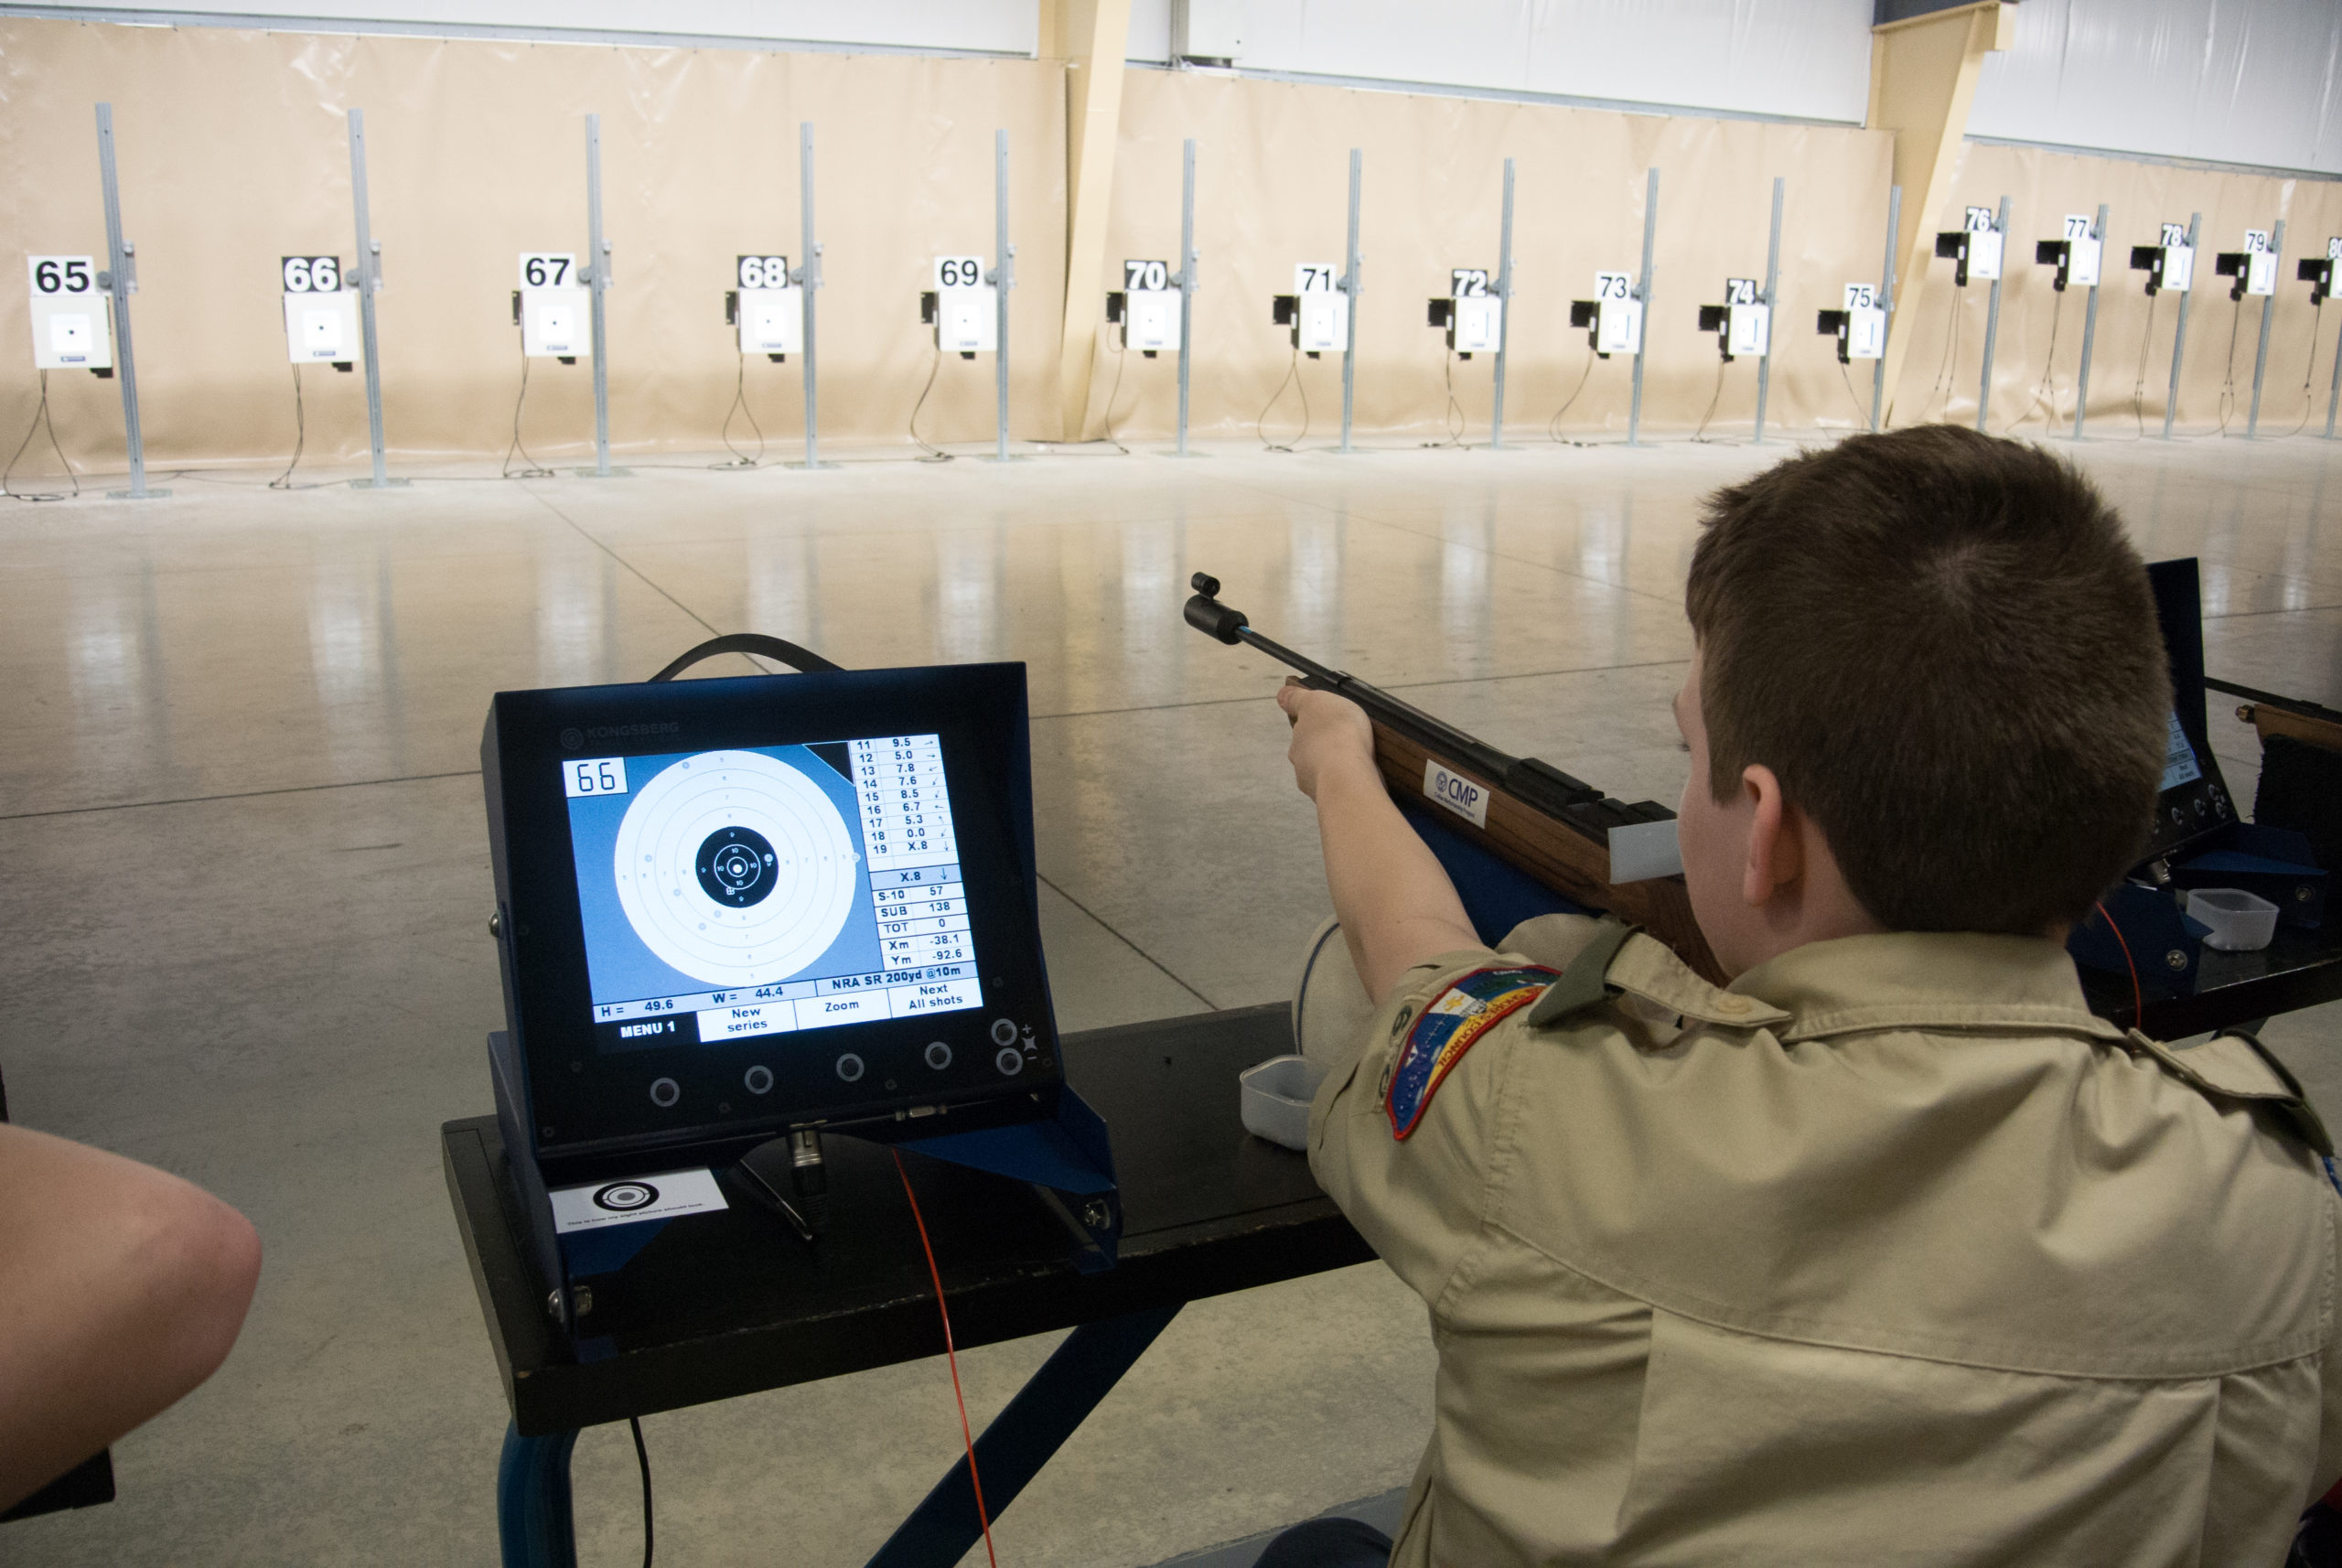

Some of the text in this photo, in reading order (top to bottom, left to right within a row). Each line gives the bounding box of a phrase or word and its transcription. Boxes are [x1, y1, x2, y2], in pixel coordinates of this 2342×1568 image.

[1967, 208, 1991, 231] 76
[2068, 219, 2086, 237] 77
[2161, 224, 2182, 246] 78
[2248, 233, 2264, 252] 79
[36, 261, 90, 293] 65
[284, 257, 338, 293] 66
[526, 257, 569, 286] 67
[739, 256, 787, 289] 68
[941, 260, 978, 286] 69
[1125, 262, 1166, 291] 70
[1303, 268, 1329, 291] 71
[1453, 271, 1488, 297] 72
[1601, 276, 1627, 298] 73
[1728, 280, 1756, 305] 74
[1849, 287, 1870, 307] 75
[586, 723, 681, 738] KONGSBERG
[857, 737, 911, 750] 11 9.5
[859, 750, 912, 763] 12 5.0
[577, 762, 615, 791] 66
[862, 763, 915, 776] 13 7.8
[864, 776, 917, 789] 14 7.6
[865, 789, 919, 801] 15 8.5
[1449, 779, 1478, 807] CMP
[867, 802, 920, 815] 16 6.7
[869, 815, 923, 828] 17 5.3
[872, 828, 925, 841] 18 0.0
[874, 841, 928, 854] 19 X.8
[900, 872, 921, 882] X.8
[878, 886, 943, 901] S-10 57
[881, 902, 951, 917] SUB 138
[884, 918, 946, 933] TOT 0
[889, 934, 959, 950] Xm -38.1
[891, 949, 962, 965] Ym -92.6
[833, 967, 961, 990] NRA SR 200yd @10m
[713, 993, 725, 1004] W
[756, 986, 783, 998] 44.4
[920, 984, 948, 995] Next
[601, 1007, 611, 1016] H
[645, 1000, 673, 1011] 49.6
[825, 1001, 859, 1012] Zoom
[908, 995, 963, 1009] All shots
[732, 1008, 761, 1019] New
[620, 1021, 675, 1038] MENU 1
[727, 1019, 768, 1032] series
[1438, 1020, 1482, 1067] COUNCIL
